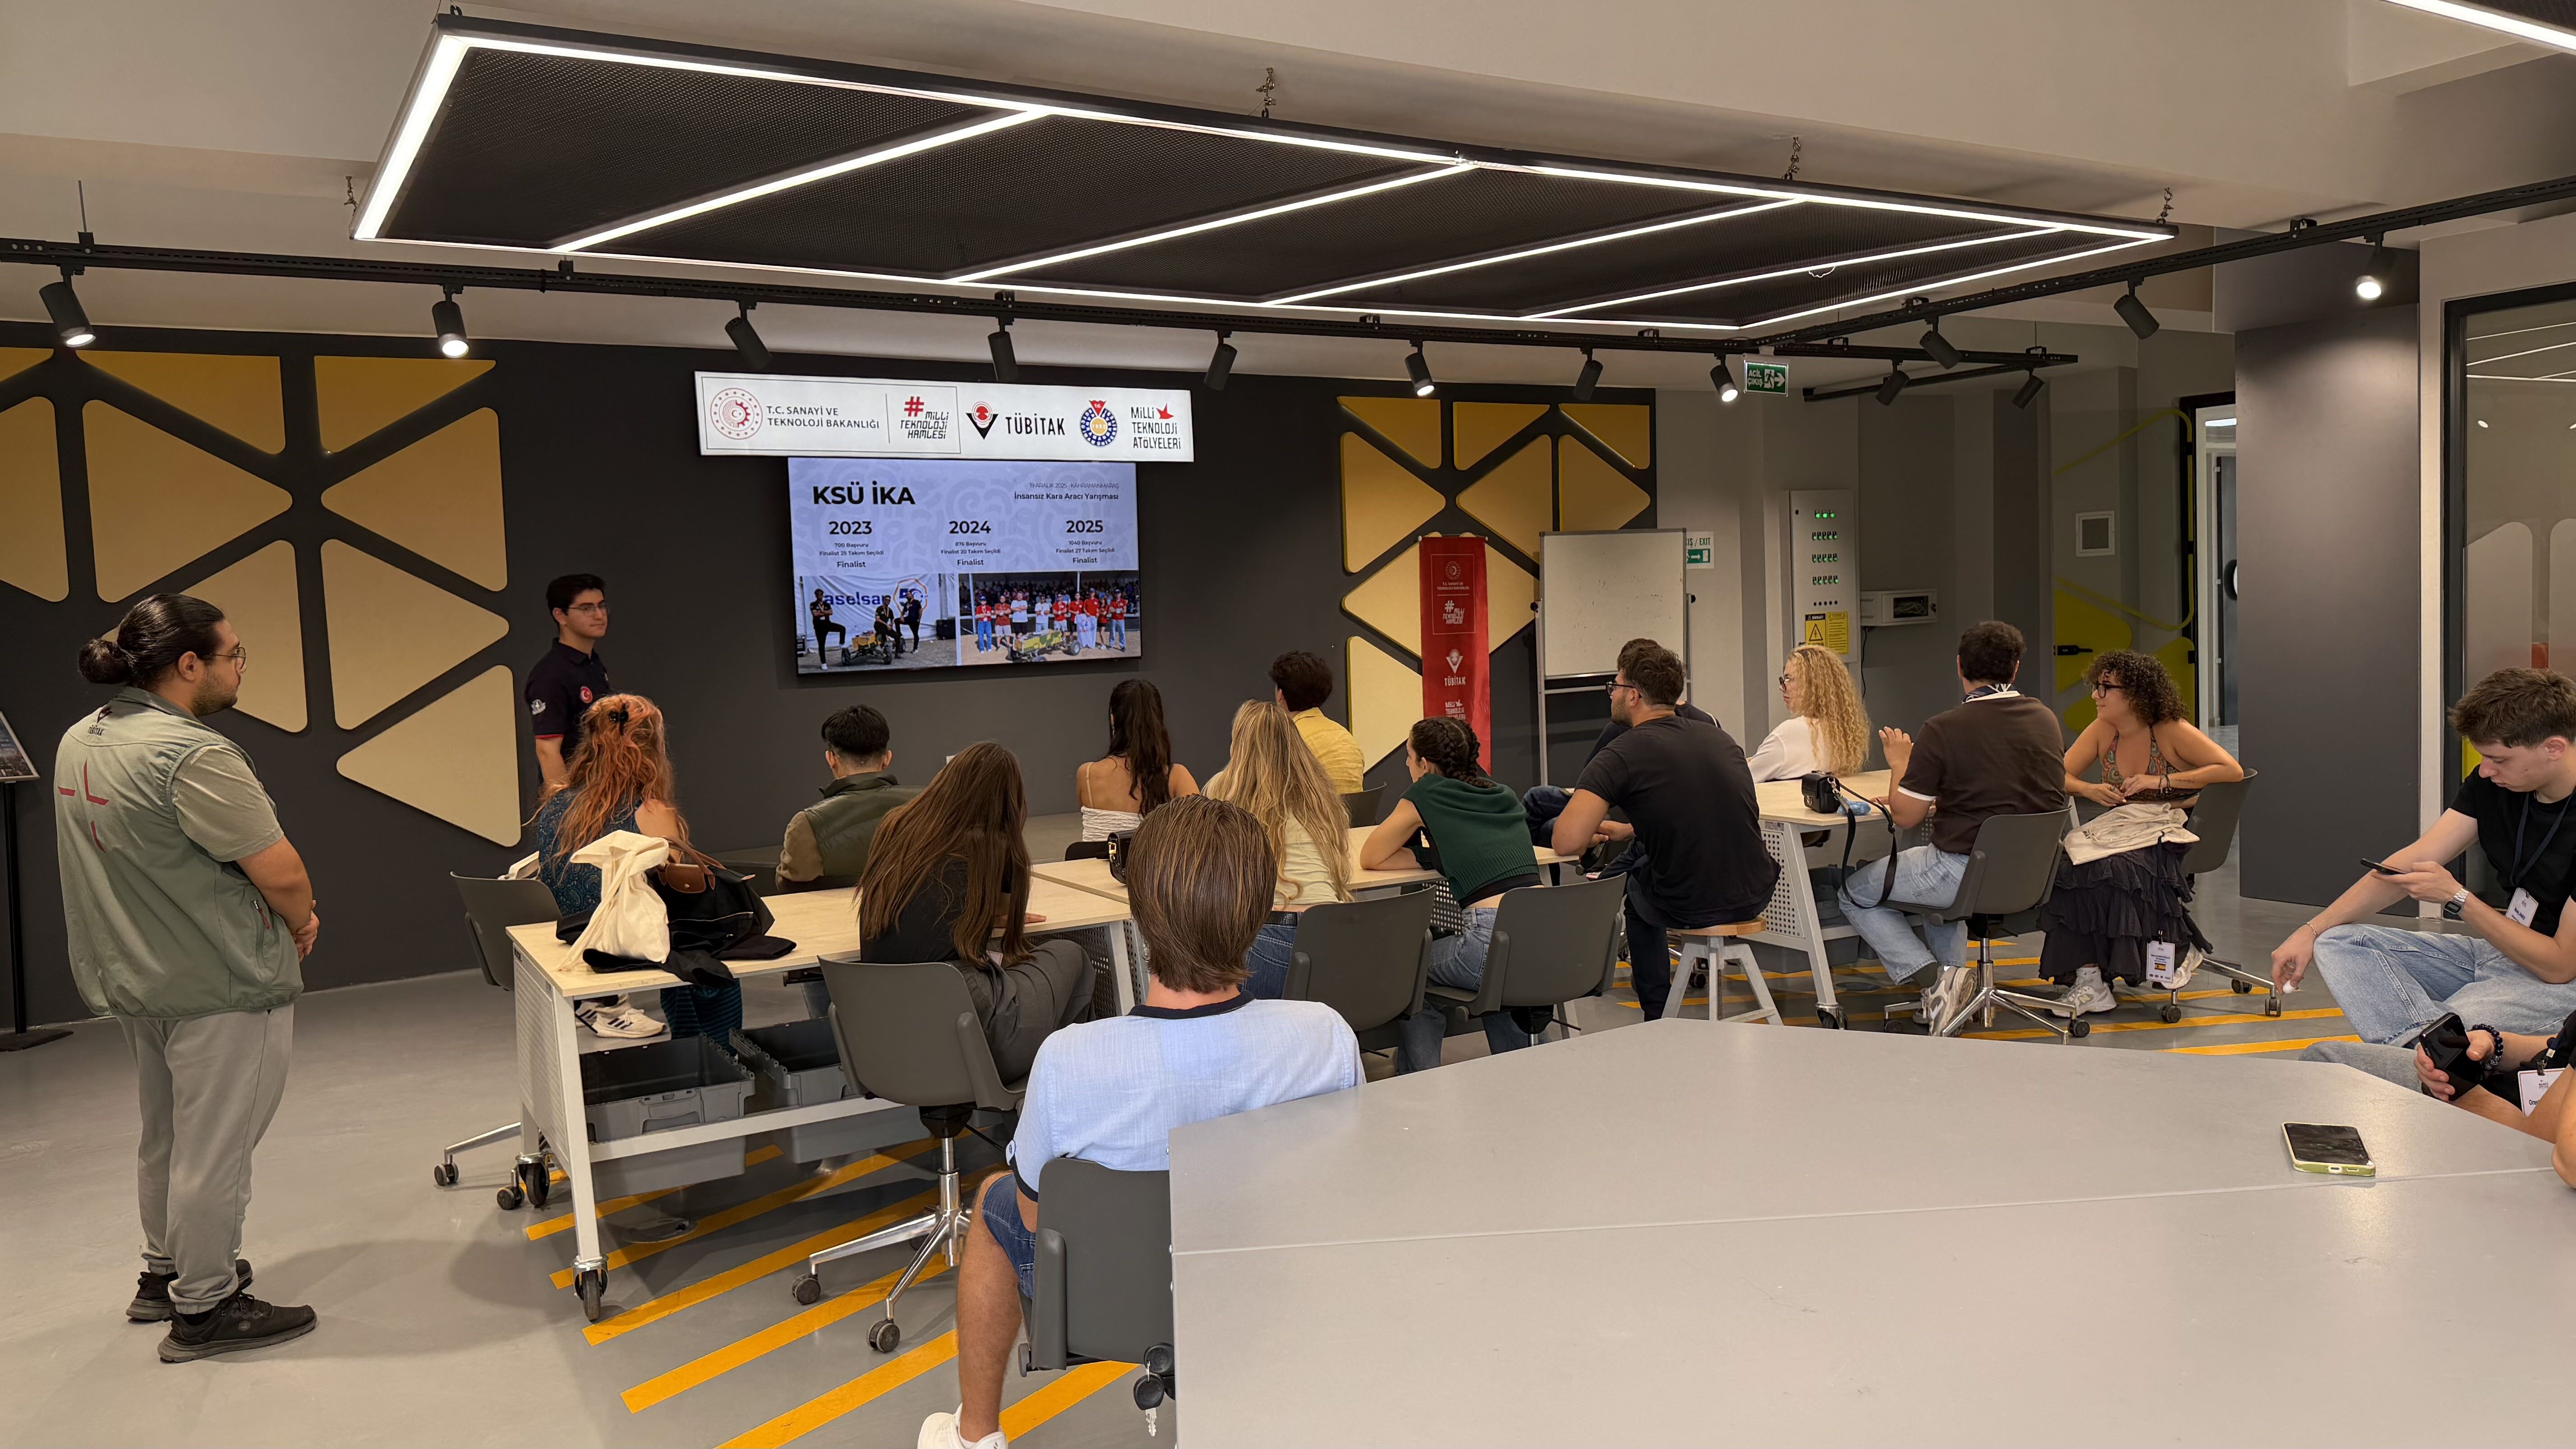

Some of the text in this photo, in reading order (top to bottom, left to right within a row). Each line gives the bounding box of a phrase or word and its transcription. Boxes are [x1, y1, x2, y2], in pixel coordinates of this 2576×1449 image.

[1748, 369, 1762, 377] ACİL
[1747, 378, 1763, 387] ÇIKIŞ
[766, 405, 839, 415] T.C. SANAYİ VE
[767, 417, 879, 429] TEKNOLOJİ BAKANLIĞI
[1005, 412, 1065, 435] TÜBİTAK
[813, 480, 916, 505] KSÜ İKA
[1014, 491, 1044, 500] İnsansız
[1084, 492, 1119, 501] Yarışması
[828, 521, 873, 535] 2023
[949, 520, 992, 534] 2024
[1066, 520, 1104, 533] 2025
[1699, 537, 1711, 546] EXIT
[1444, 676, 1466, 686] TÜBİTAK
